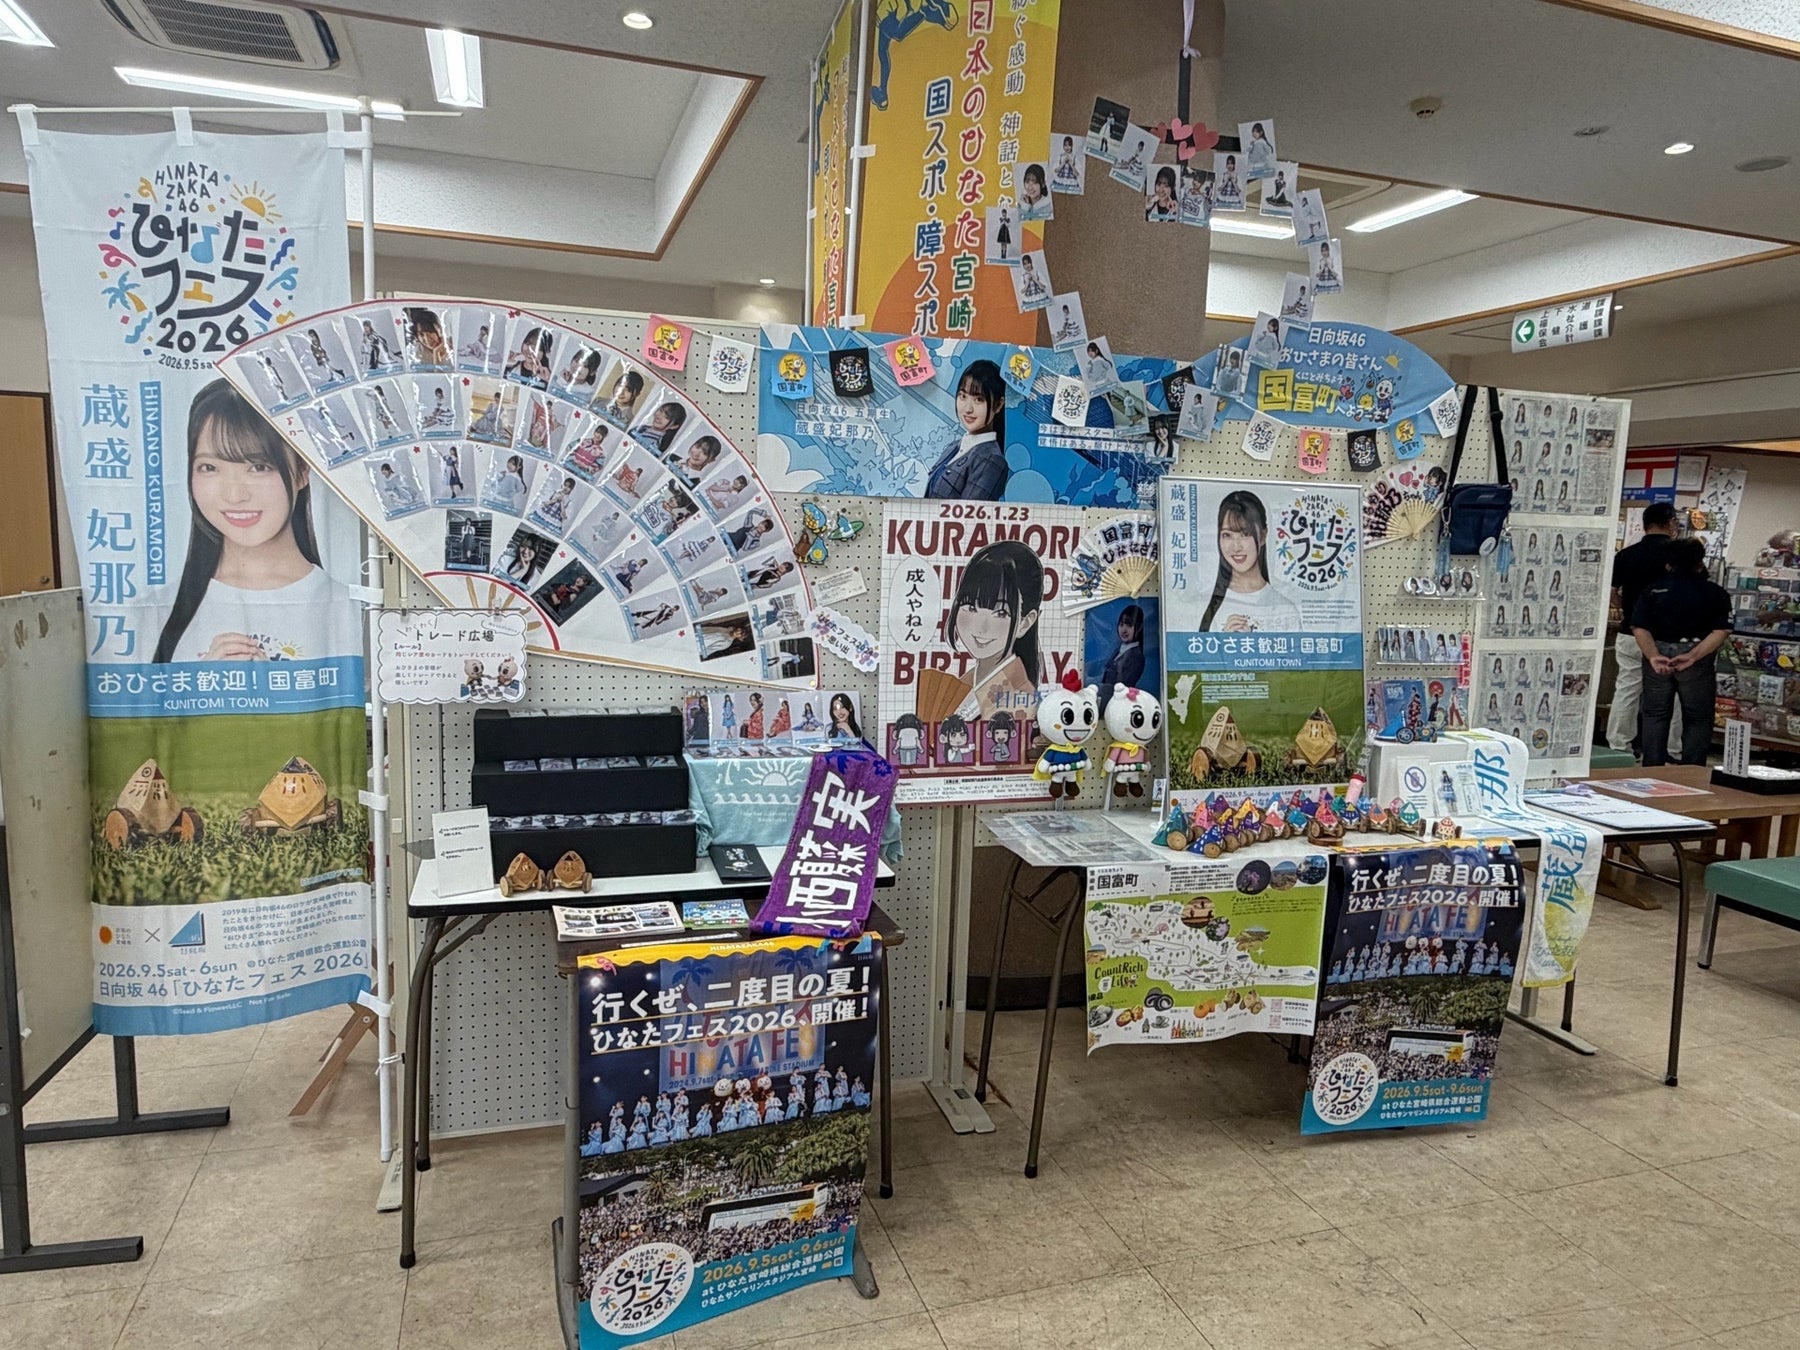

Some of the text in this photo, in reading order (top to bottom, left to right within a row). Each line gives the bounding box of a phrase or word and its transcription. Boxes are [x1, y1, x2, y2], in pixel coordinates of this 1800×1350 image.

[155, 161, 219, 186] HINATA
[166, 178, 211, 200] ZAKA
[178, 198, 200, 213] 46
[913, 77, 952, 336] 国スポ・障スポ
[131, 203, 267, 265] ひなた
[141, 258, 273, 321] フェス
[156, 314, 250, 353] 2026
[1308, 327, 1367, 347] 日向坂46
[1280, 347, 1383, 371] おひさまの皆さん
[1295, 371, 1344, 384] くにとみちょう
[1258, 369, 1341, 415] 国富町
[796, 403, 890, 419] 日向坂46 五期生
[795, 421, 875, 439] 蔵盛妃那乃
[143, 385, 165, 583] HINANO KURAMORI
[1301, 493, 1328, 505] HINATA
[1306, 502, 1325, 511] ZAKA
[80, 383, 136, 658] 蔵盛 妃那乃
[940, 504, 1030, 521] 2026.1.23
[1101, 520, 1153, 546] 国富町
[1289, 510, 1344, 541] ひなた
[1292, 536, 1345, 567] フェス
[1297, 564, 1337, 584] 2026
[905, 568, 926, 643] 成人やねん
[416, 630, 495, 642] トレード広場
[1234, 658, 1301, 668] KUNITOMI TOWN
[163, 696, 270, 710] KUNITOMI TOWN
[1097, 873, 1139, 890] 国富町
[1351, 863, 1519, 892] 行くぜ、二度目の夏！
[1349, 889, 1519, 912] ひなたフェス2026、開催！
[199, 960, 238, 975] 6sun
[591, 966, 871, 1024] 行くぜ、二度目の夏！
[591, 997, 869, 1052] ひなたフェス2026、開催！
[1328, 1069, 1365, 1086] ひなた
[1329, 1086, 1364, 1105] フェス
[1329, 1101, 1357, 1115] 2026
[614, 1260, 673, 1288] ひなた
[701, 1246, 845, 1297] at ひなた宮崎県総合運動公園
[617, 1278, 673, 1308] フェス
[701, 1265, 817, 1308] ひなたサンマリンスタジアム宮崎
[621, 1297, 663, 1321] 2026
